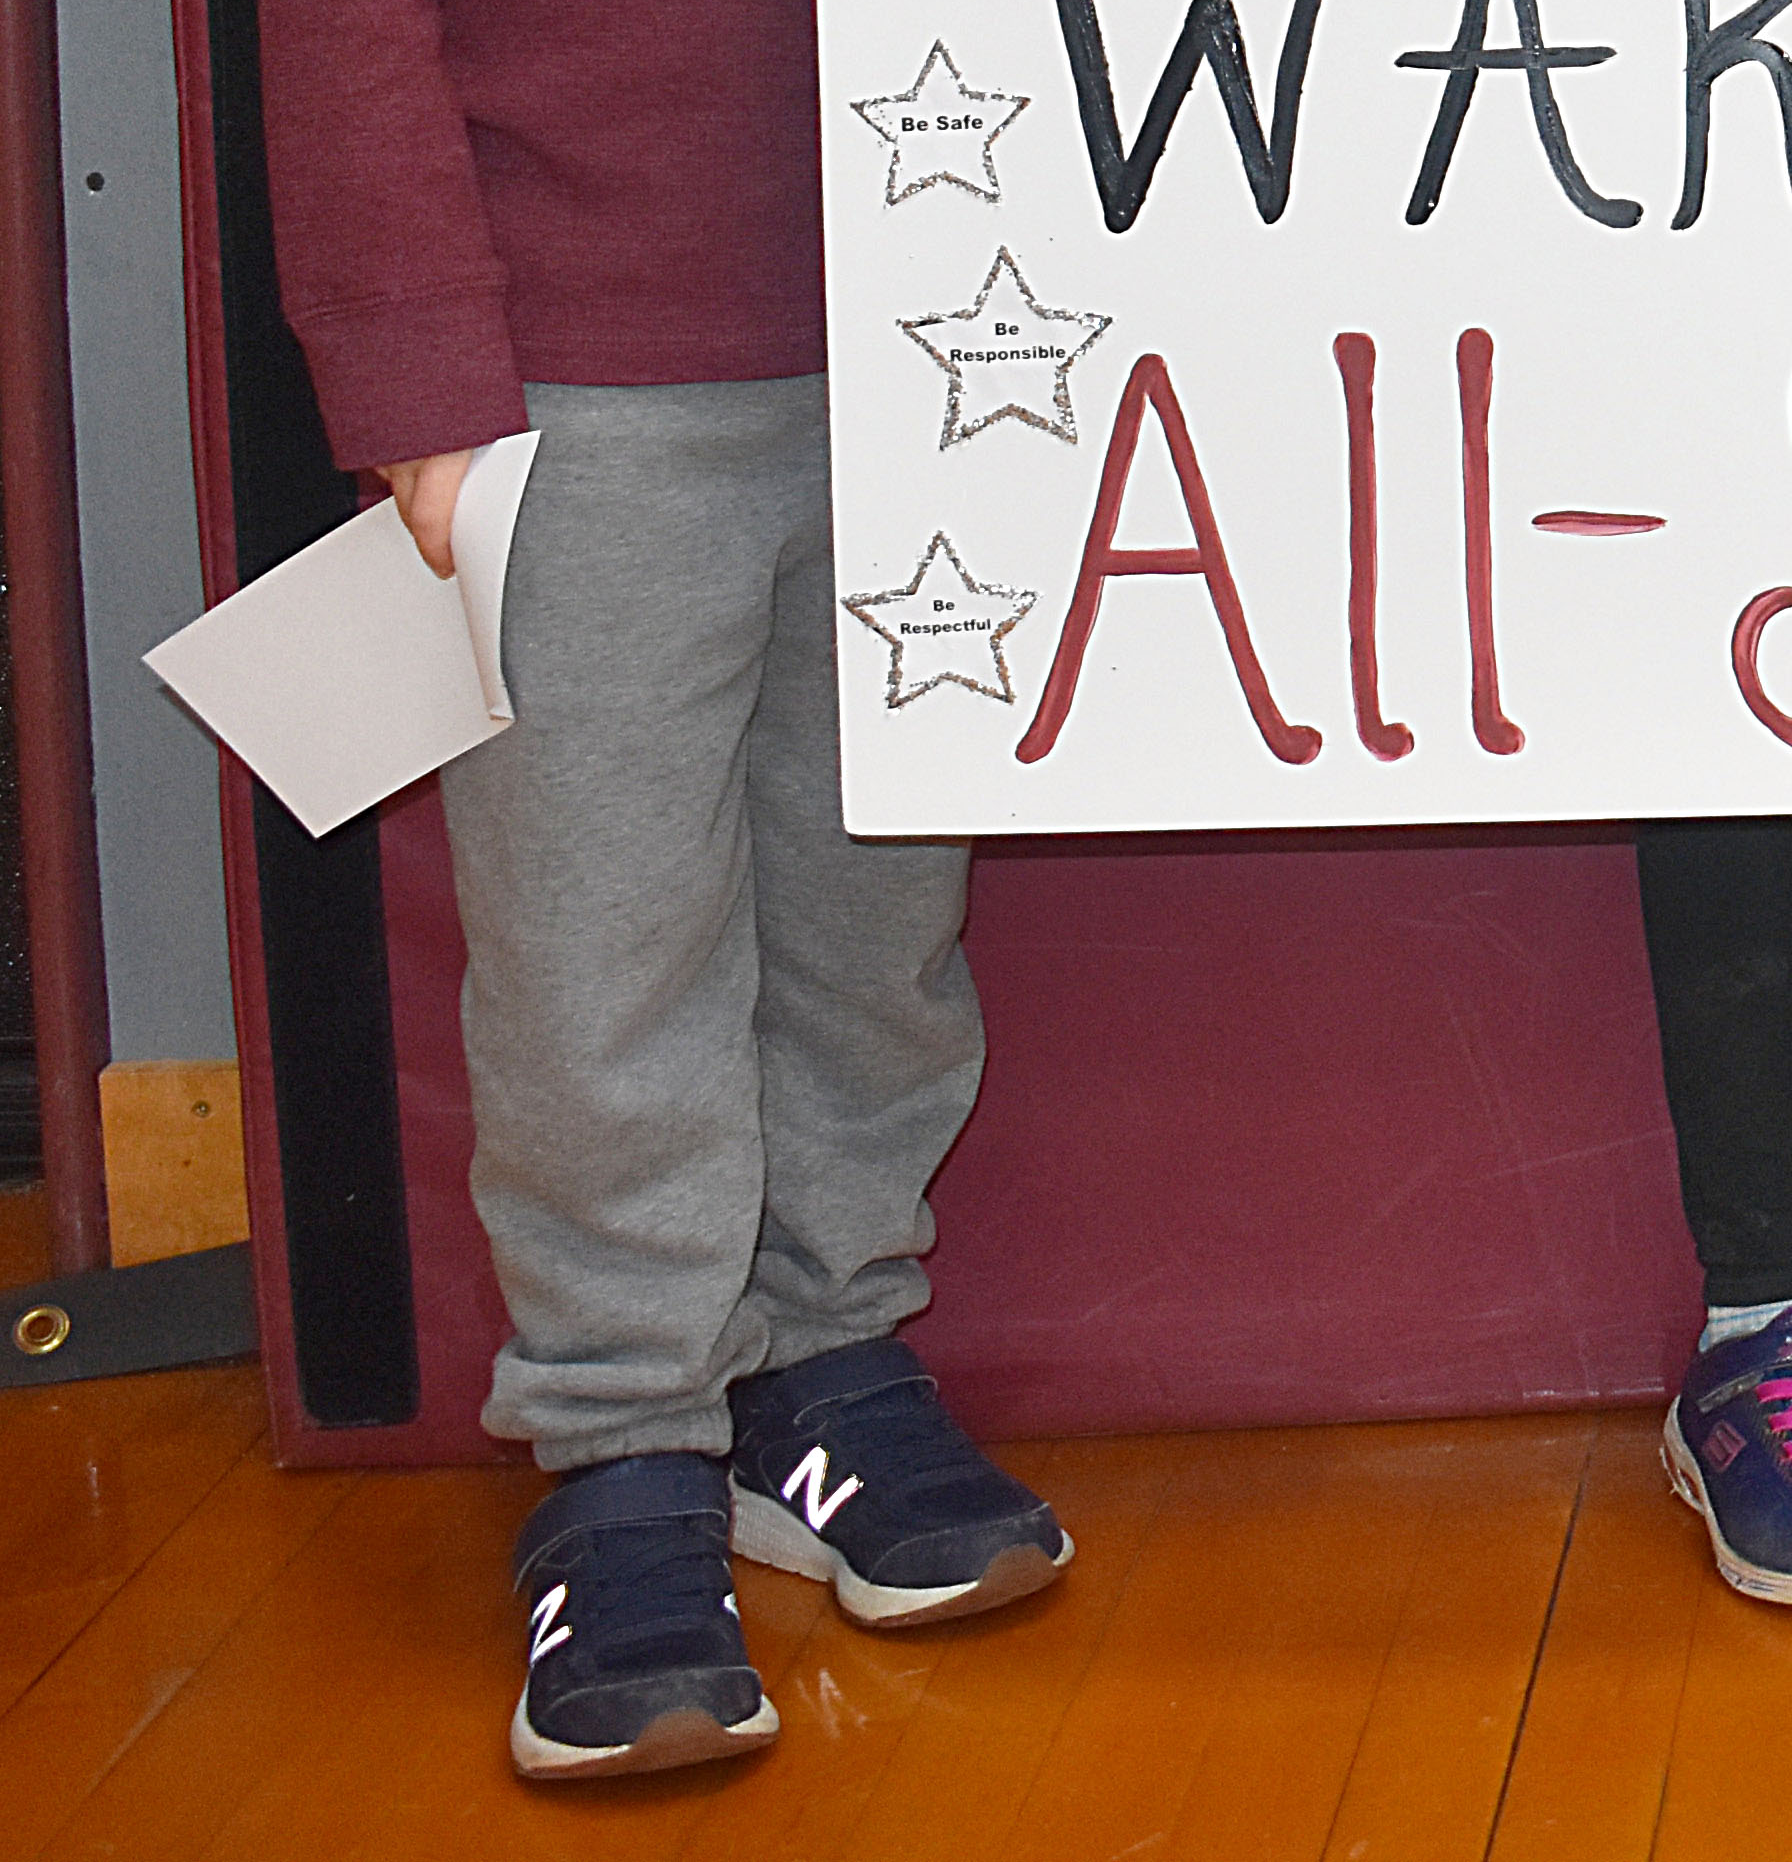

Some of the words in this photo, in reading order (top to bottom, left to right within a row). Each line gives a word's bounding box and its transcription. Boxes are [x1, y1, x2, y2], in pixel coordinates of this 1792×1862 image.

[901, 116, 929, 132] Be
[936, 115, 984, 131] Safe
[994, 322, 1020, 337] Be
[949, 345, 1067, 364] Responsible
[932, 599, 955, 612] Be
[899, 618, 992, 636] Respectful
